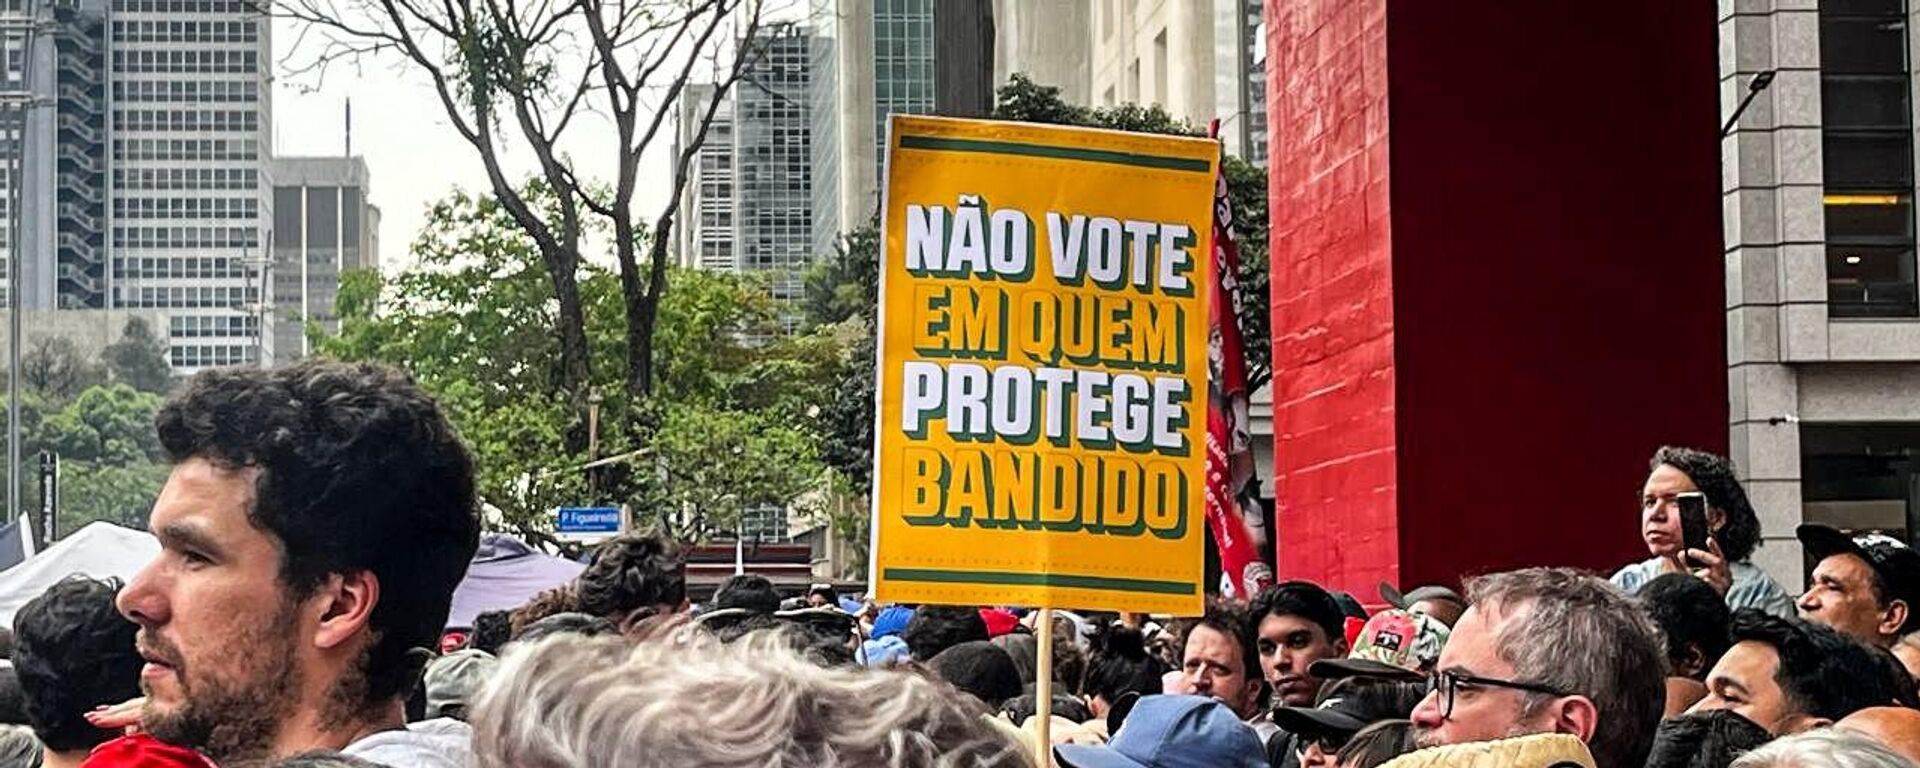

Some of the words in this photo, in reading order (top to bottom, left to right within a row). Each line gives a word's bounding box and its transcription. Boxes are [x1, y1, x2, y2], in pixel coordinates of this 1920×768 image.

[905, 194, 1034, 281] NÃO
[1046, 211, 1196, 297] VOTE
[914, 284, 1008, 360] EM
[1020, 288, 1185, 373] QUEM
[902, 361, 1193, 457] PROTEGE
[902, 446, 1189, 540] BANDIDO
